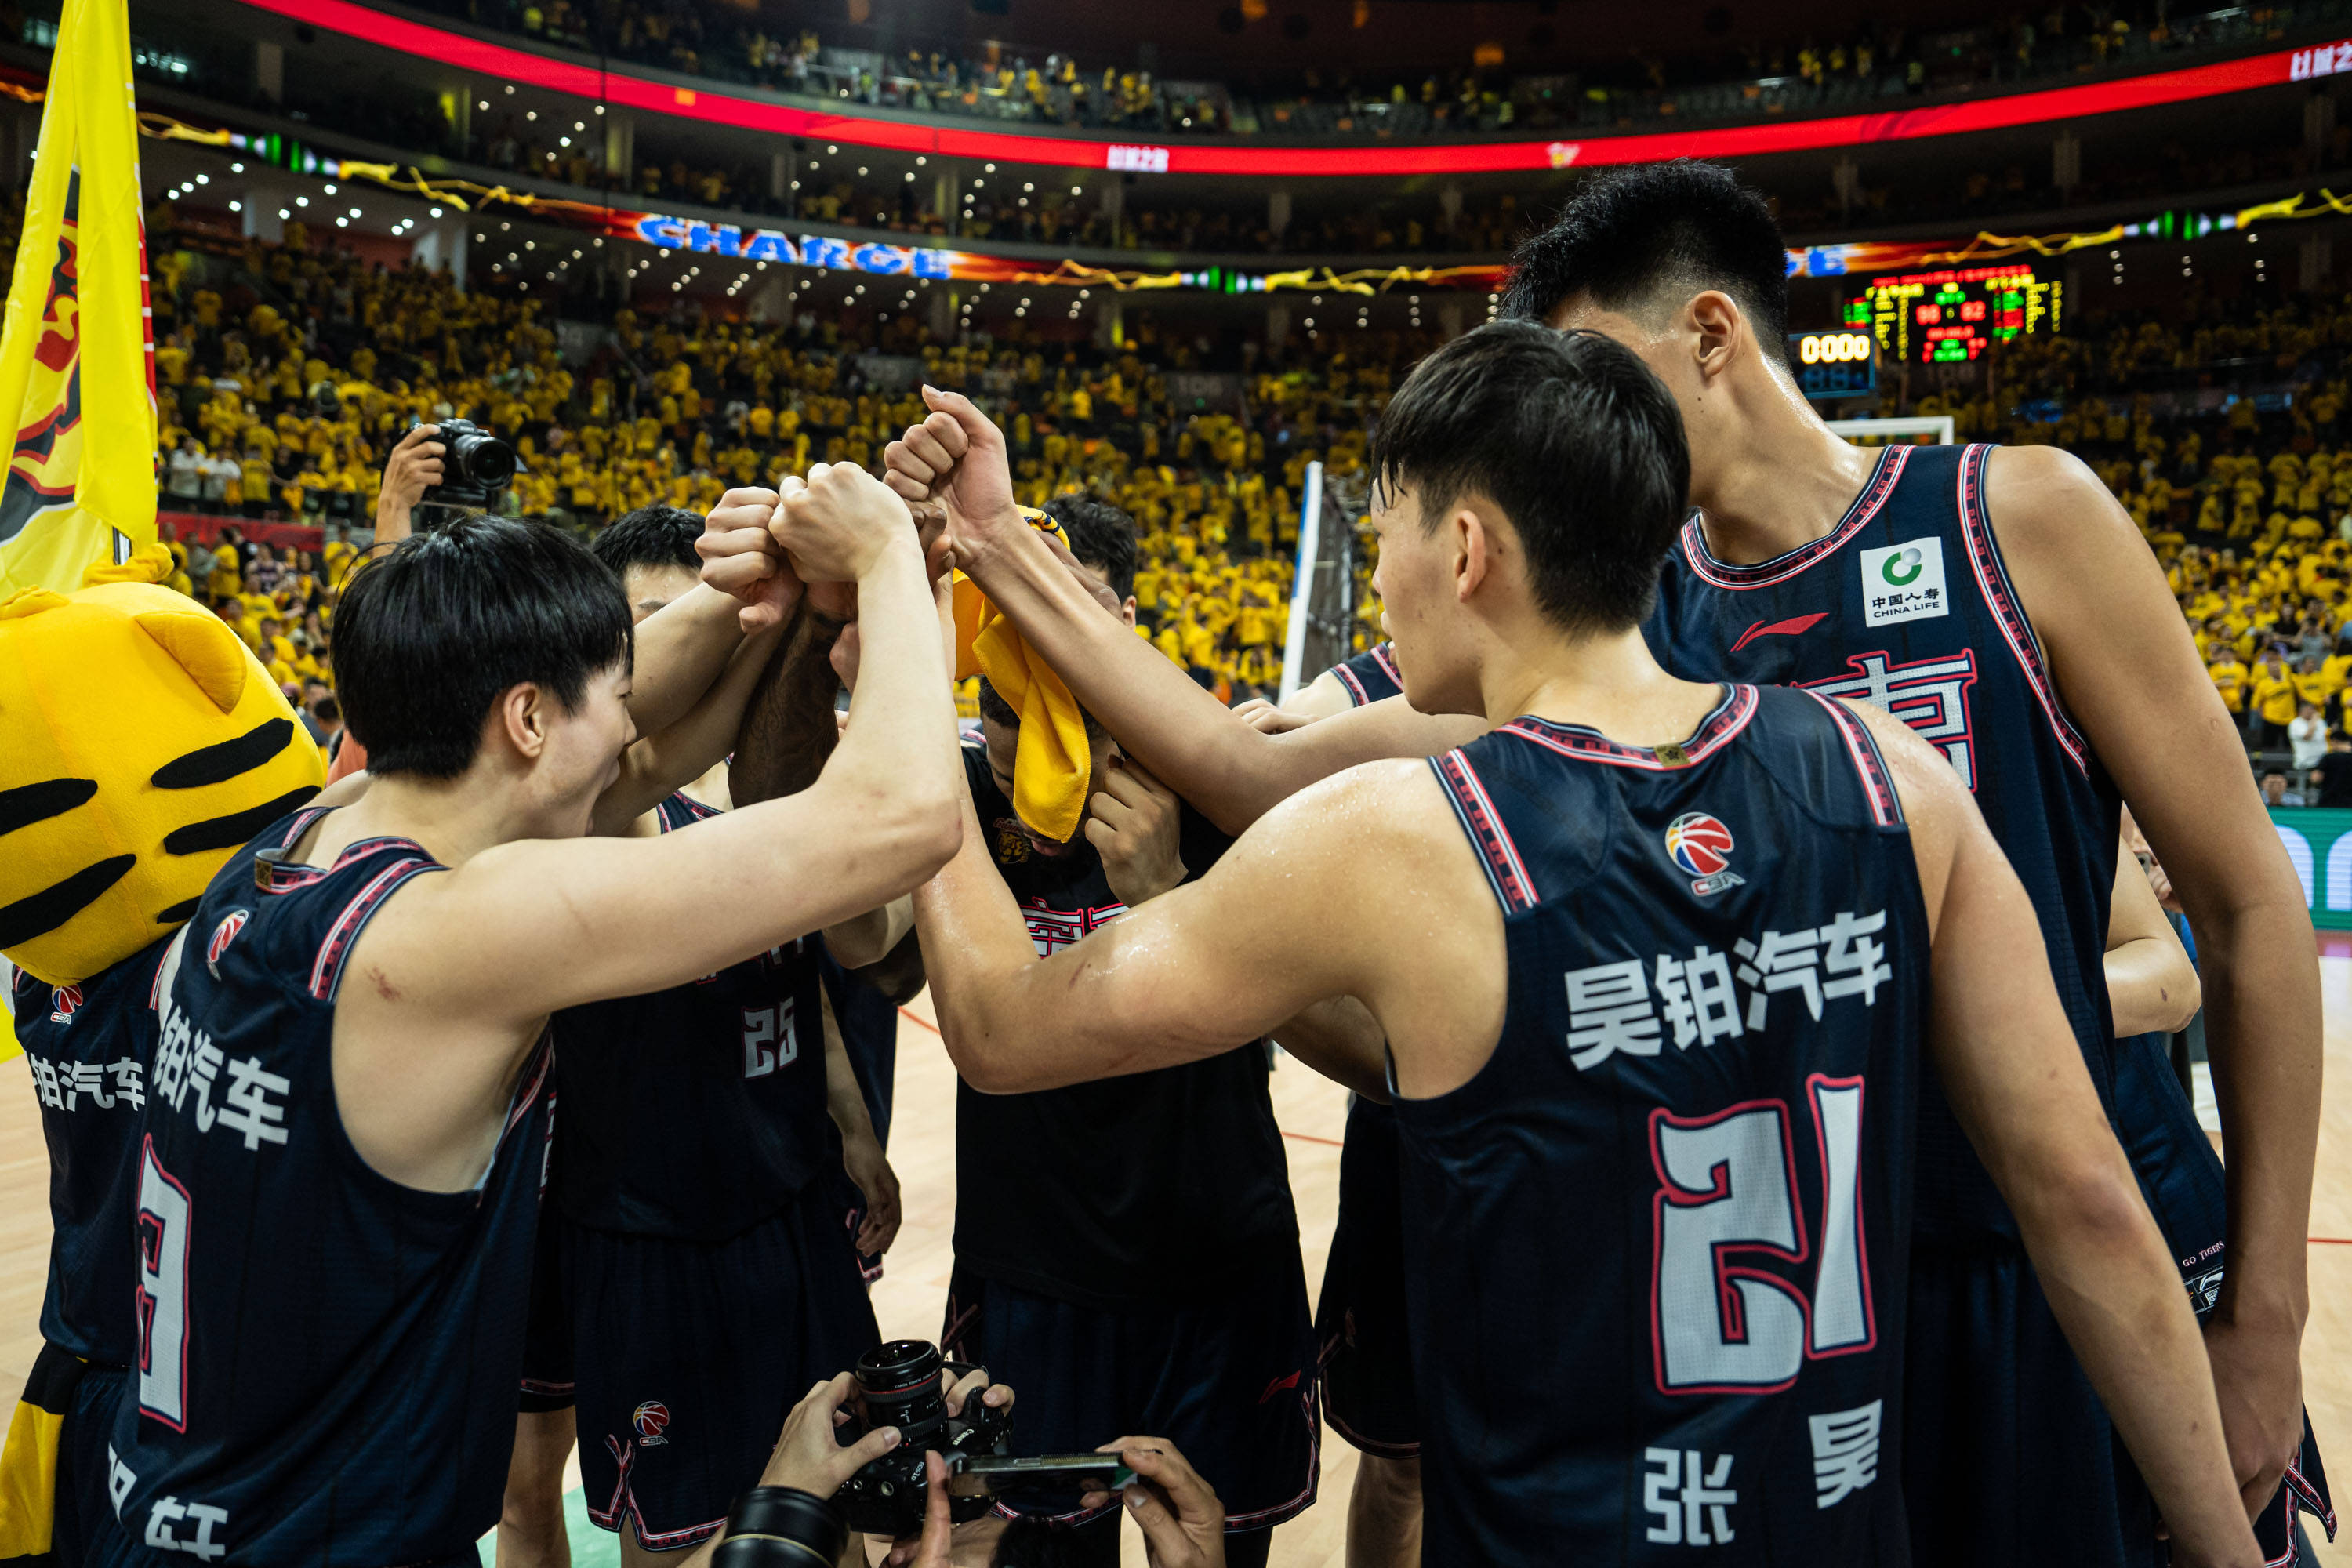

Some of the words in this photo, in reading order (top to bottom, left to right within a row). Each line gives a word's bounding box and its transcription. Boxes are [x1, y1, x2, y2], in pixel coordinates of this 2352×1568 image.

[636, 213, 952, 280] CHARGE
[1871, 588, 1940, 609] 中国人寿
[1873, 606, 1911, 618] CHINA
[1914, 601, 1940, 611] LIFE
[1691, 872, 1747, 897] CBA
[1564, 909, 1893, 1072] 昊铂汽车
[51, 1012, 72, 1025] CBA
[741, 995, 798, 1080] 25
[1648, 1073, 1877, 1395] 21
[2183, 1256, 2197, 1267] GO
[2198, 1240, 2225, 1261] TIGERS
[640, 1436, 669, 1446] CBA
[952, 1428, 975, 1446] Canon
